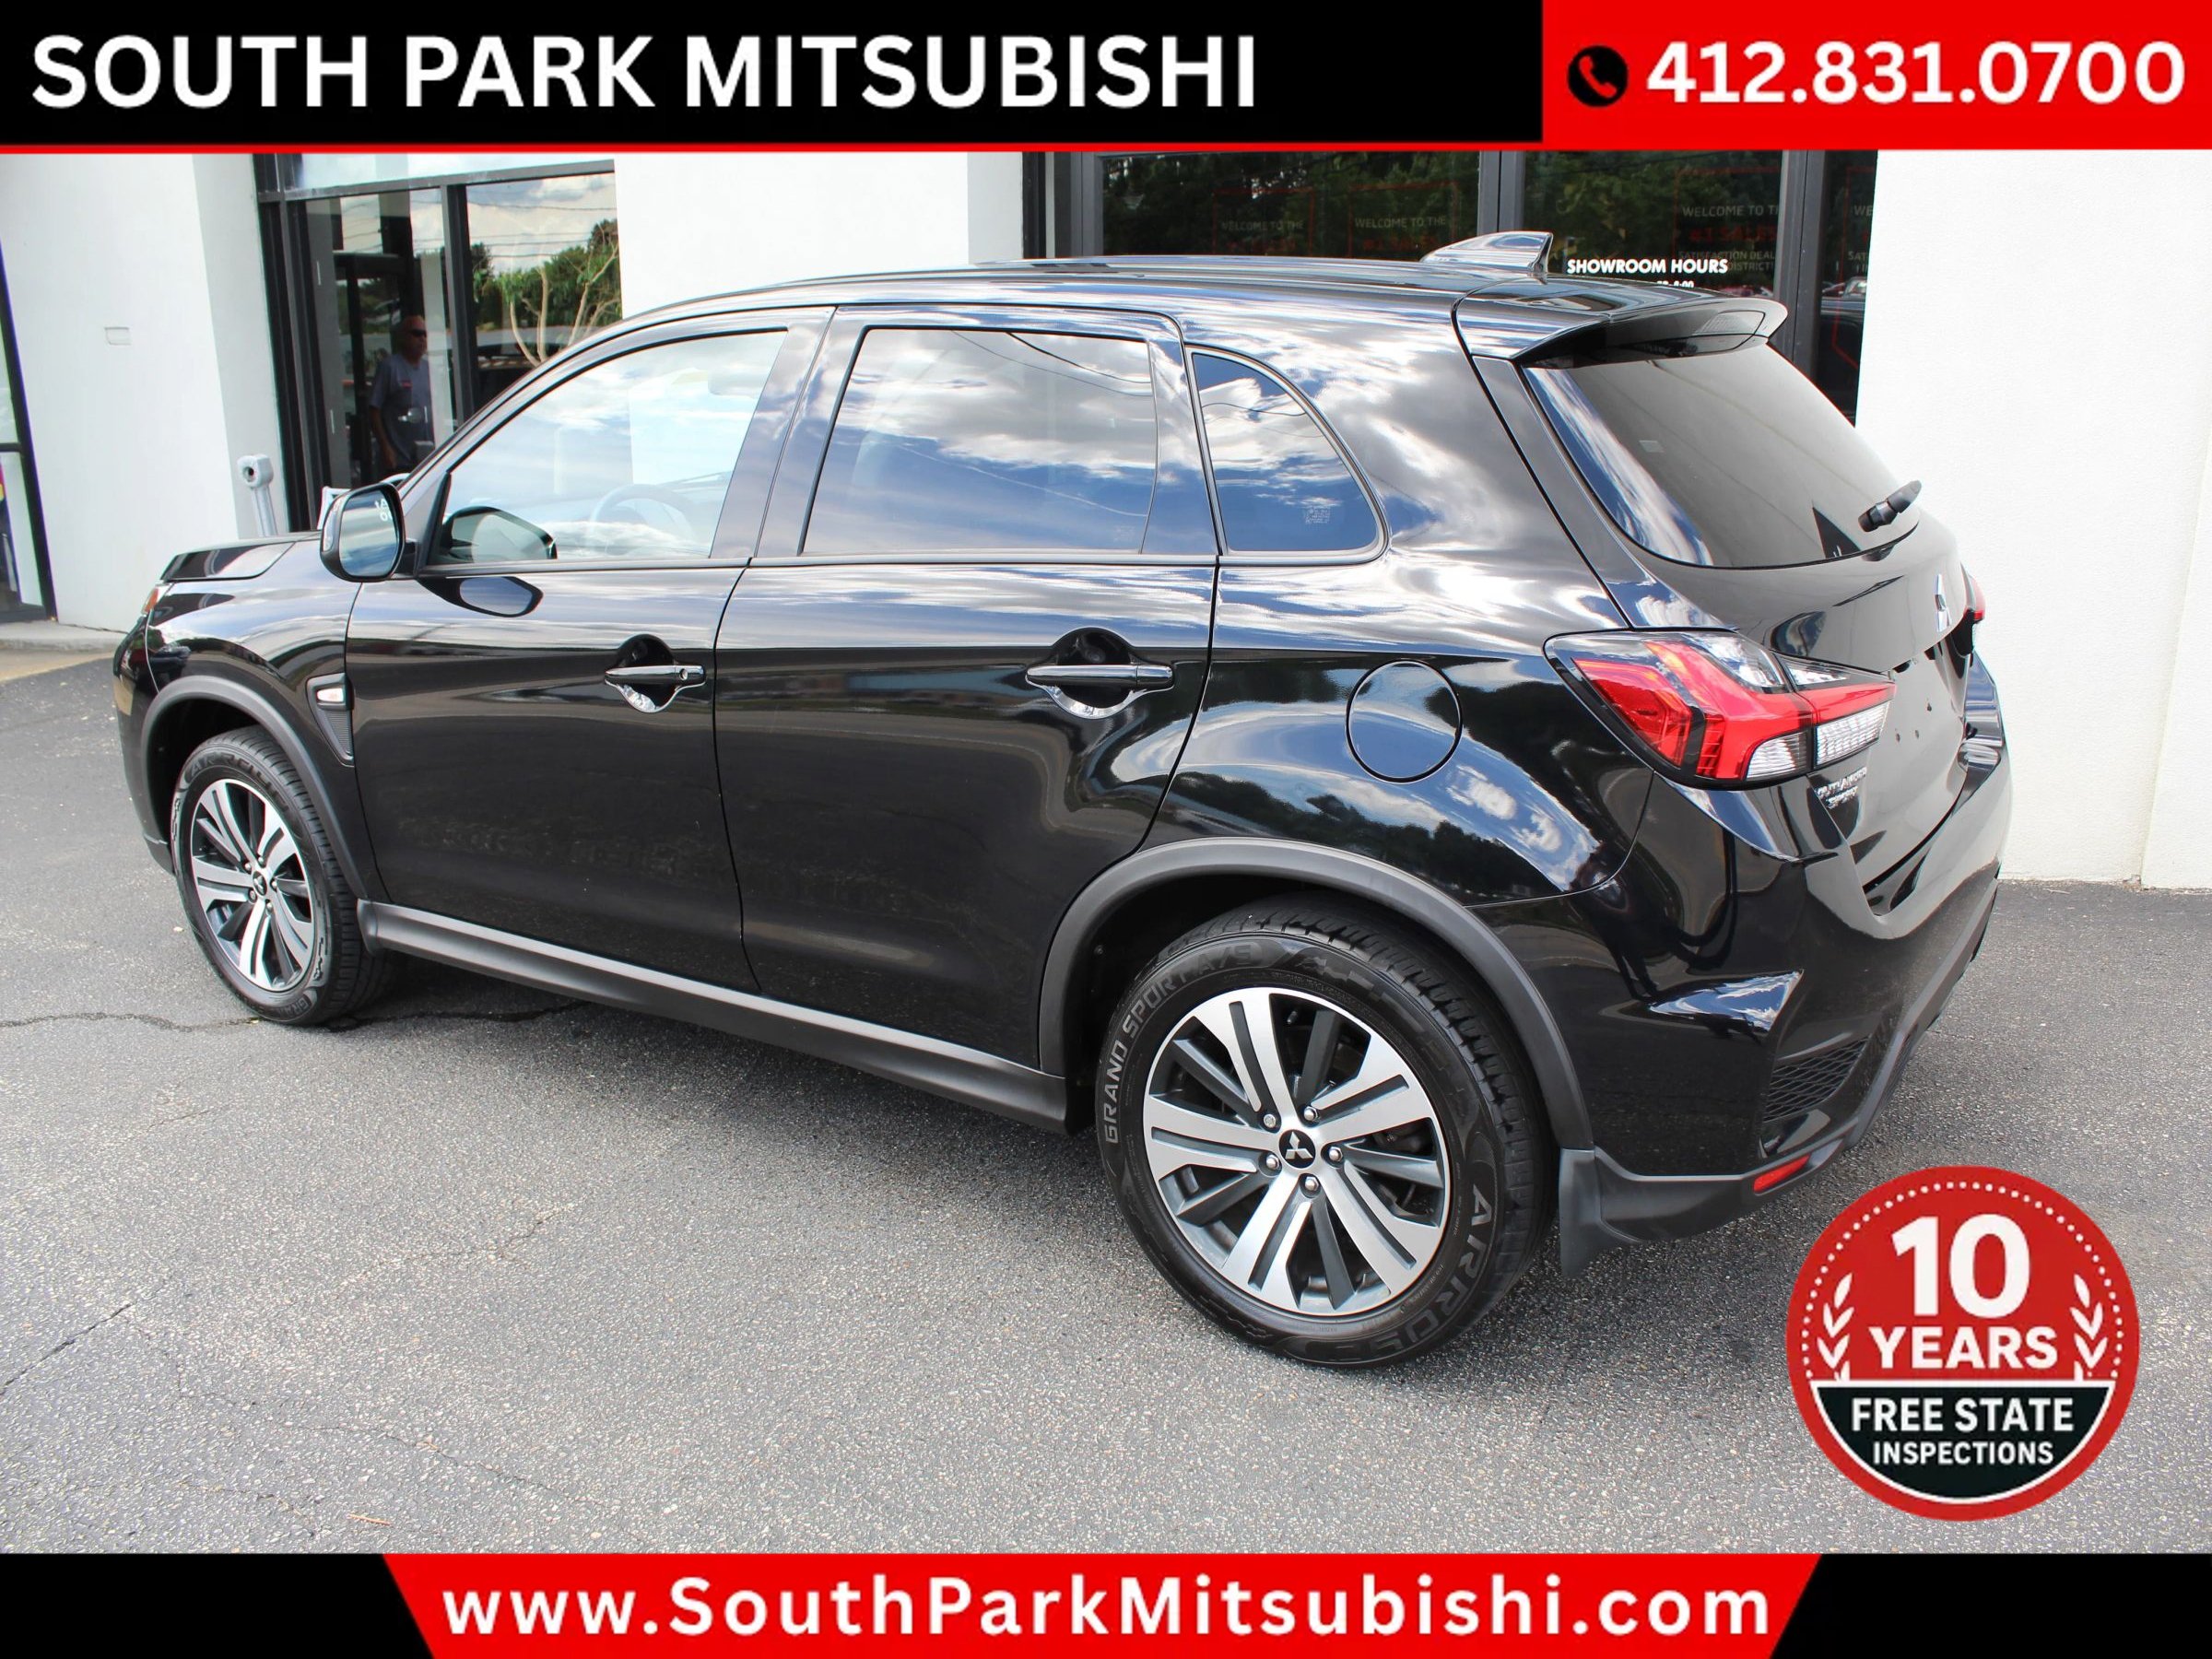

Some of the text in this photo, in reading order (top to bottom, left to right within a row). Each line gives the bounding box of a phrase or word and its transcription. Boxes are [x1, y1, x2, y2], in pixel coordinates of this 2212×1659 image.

[1681, 205, 1745, 218] WELCOME
[1747, 205, 1764, 216] TO
[1354, 216, 1446, 229] WELCOME TO THE
[1749, 250, 1776, 260] DEAL
[1567, 258, 1729, 275] SHOWROOM HOURS
[1103, 1039, 1129, 1145] GRAND
